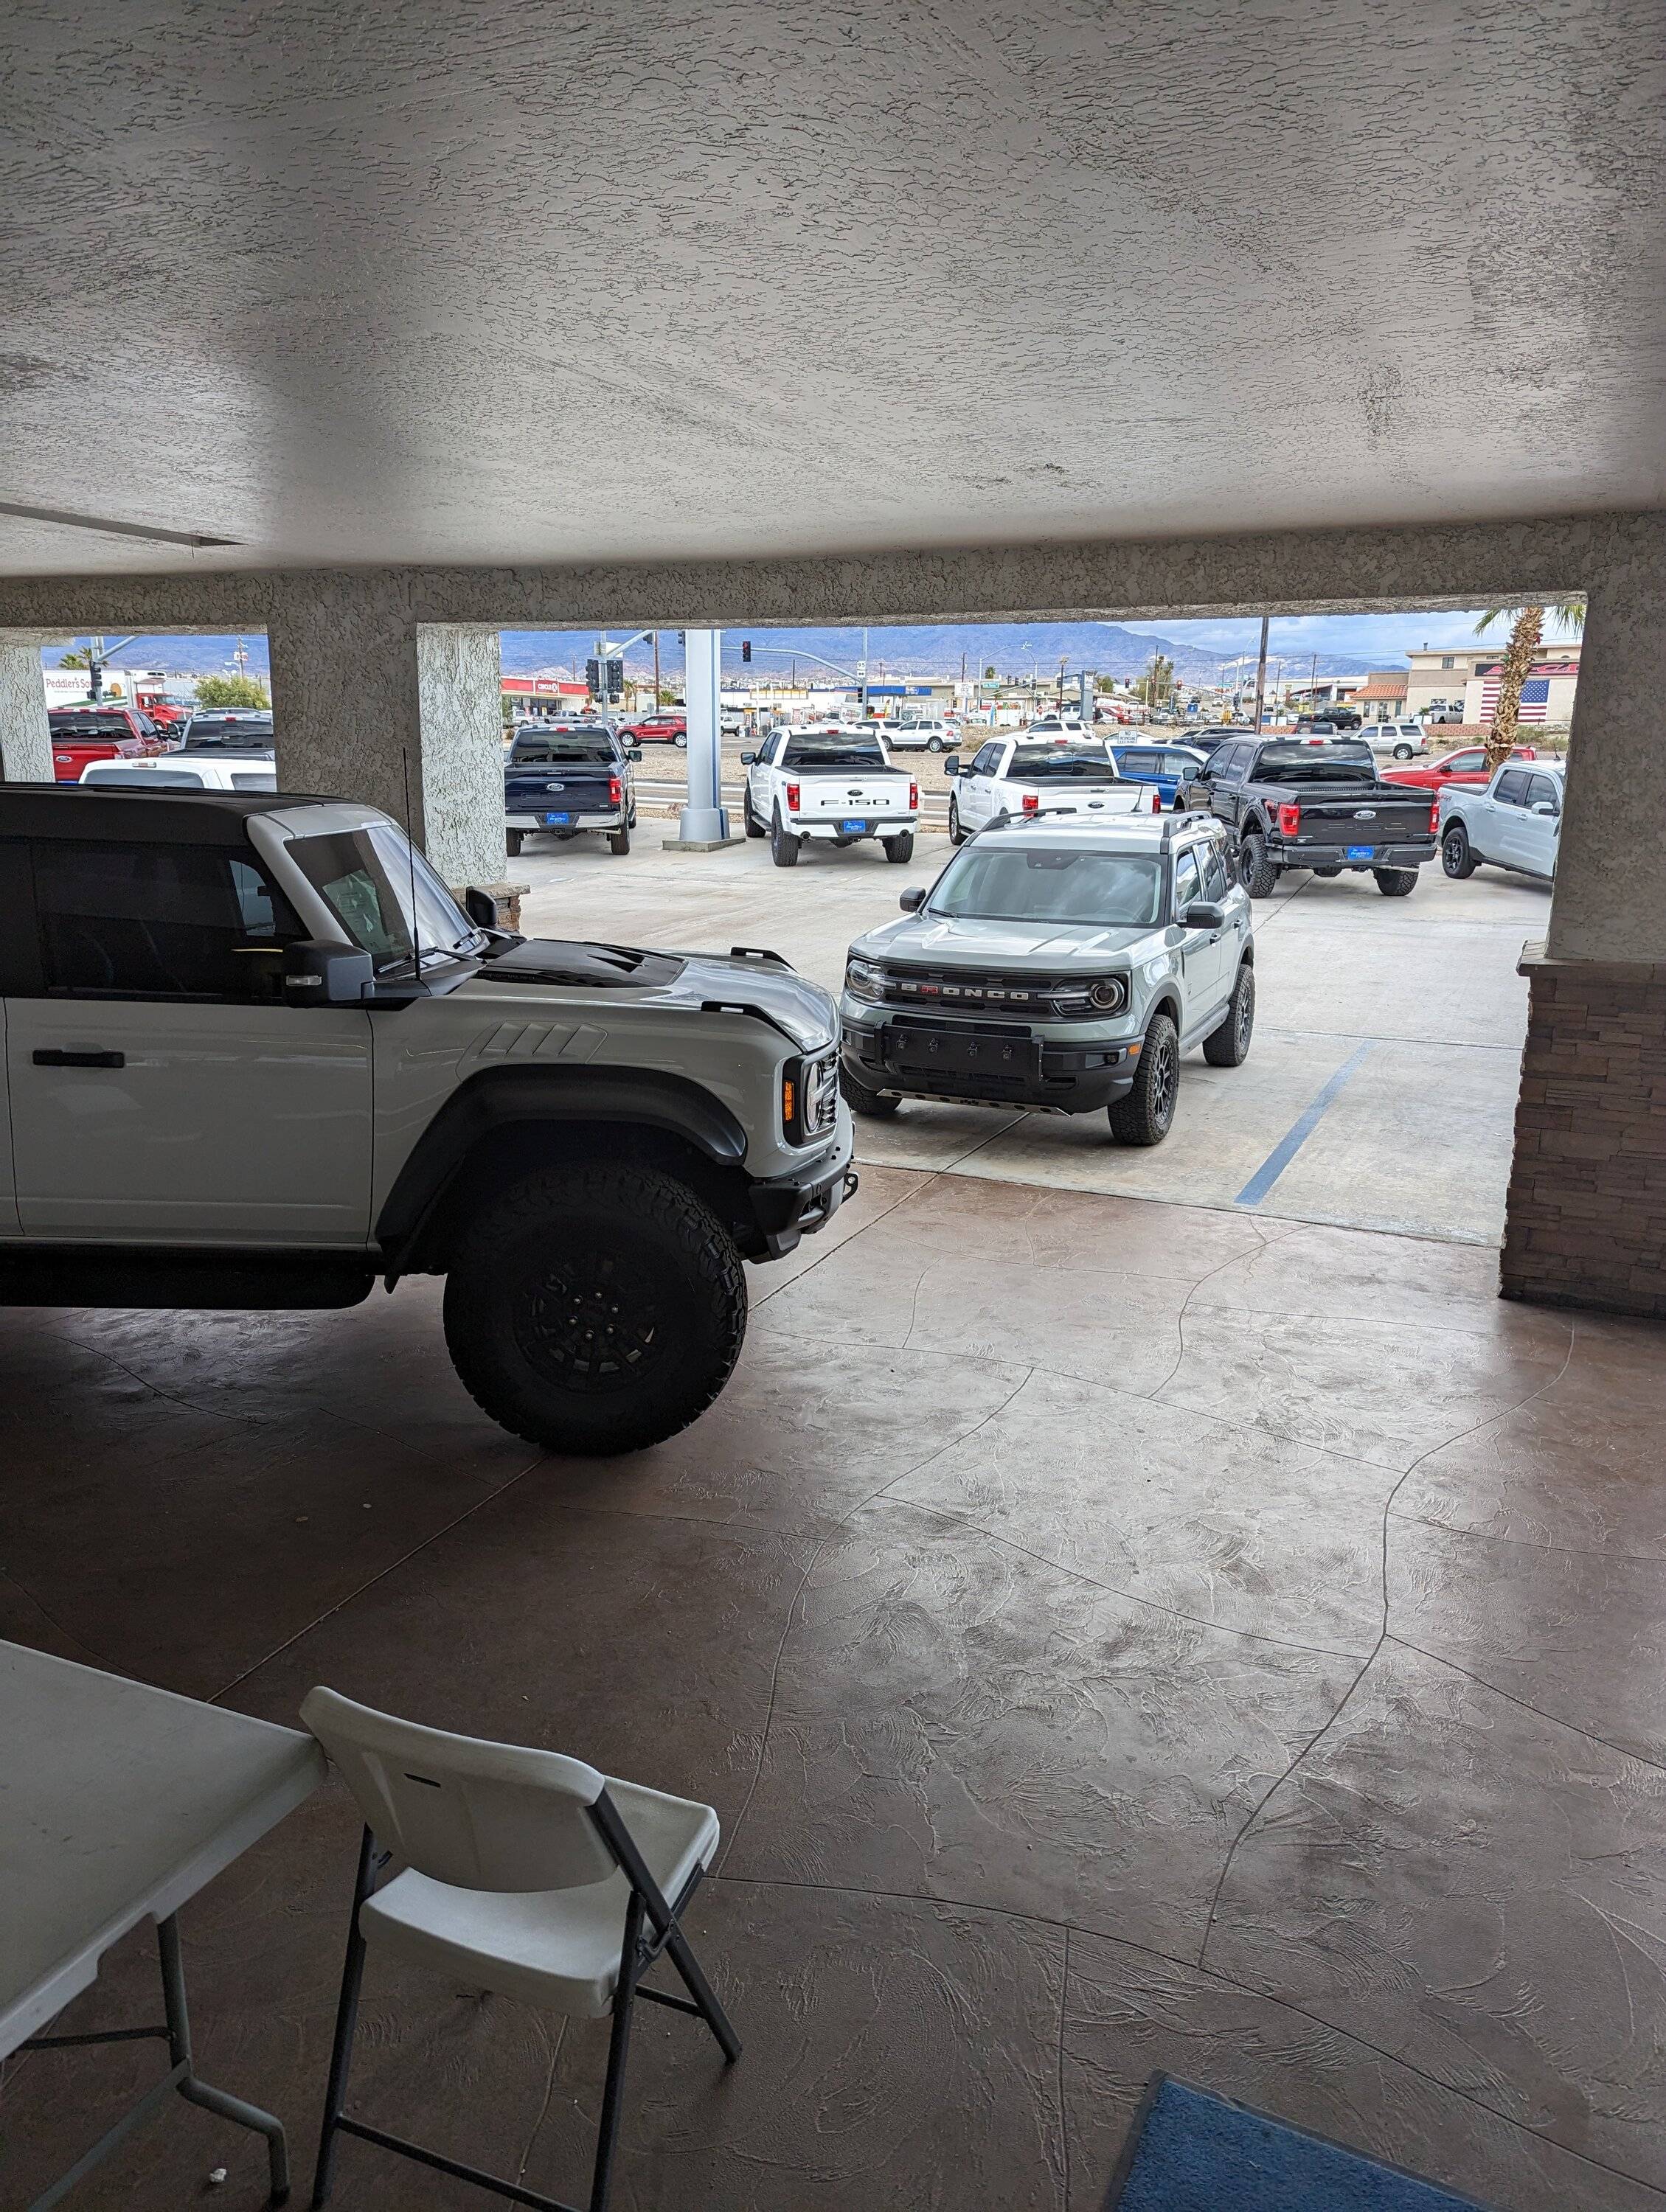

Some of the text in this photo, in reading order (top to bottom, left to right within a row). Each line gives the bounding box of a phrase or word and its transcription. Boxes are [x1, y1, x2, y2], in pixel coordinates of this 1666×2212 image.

[46, 677, 93, 689] Peddler's So
[901, 983, 1029, 1001] BRONCO
